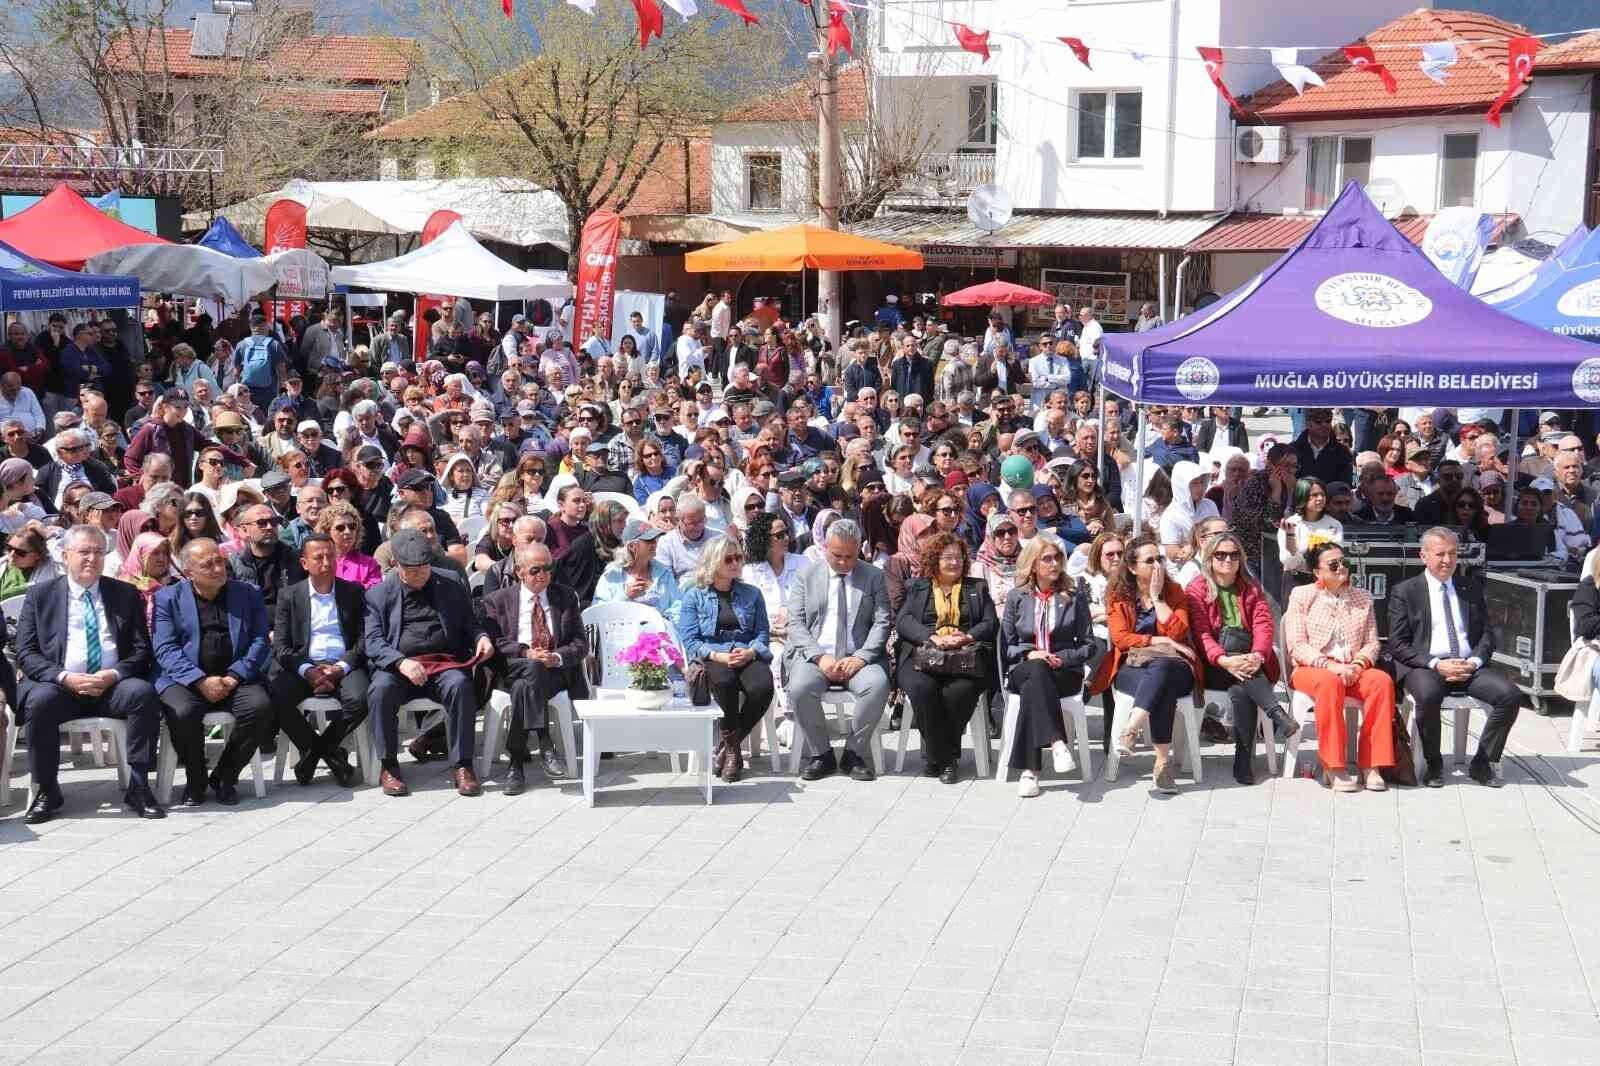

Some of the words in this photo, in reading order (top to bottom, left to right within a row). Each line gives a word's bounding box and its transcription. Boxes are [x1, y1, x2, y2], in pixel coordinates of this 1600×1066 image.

[972, 247, 1004, 256] ESTATE
[41, 285, 75, 298] BELEDİYESİ
[76, 286, 98, 297] KÜLTÜR
[580, 281, 597, 347] ETHİYE
[1255, 371, 1319, 389] MUĞLA
[1323, 371, 1435, 392] BÜYÜKŞEHİR
[1438, 371, 1538, 390] BELEDİYESİ
